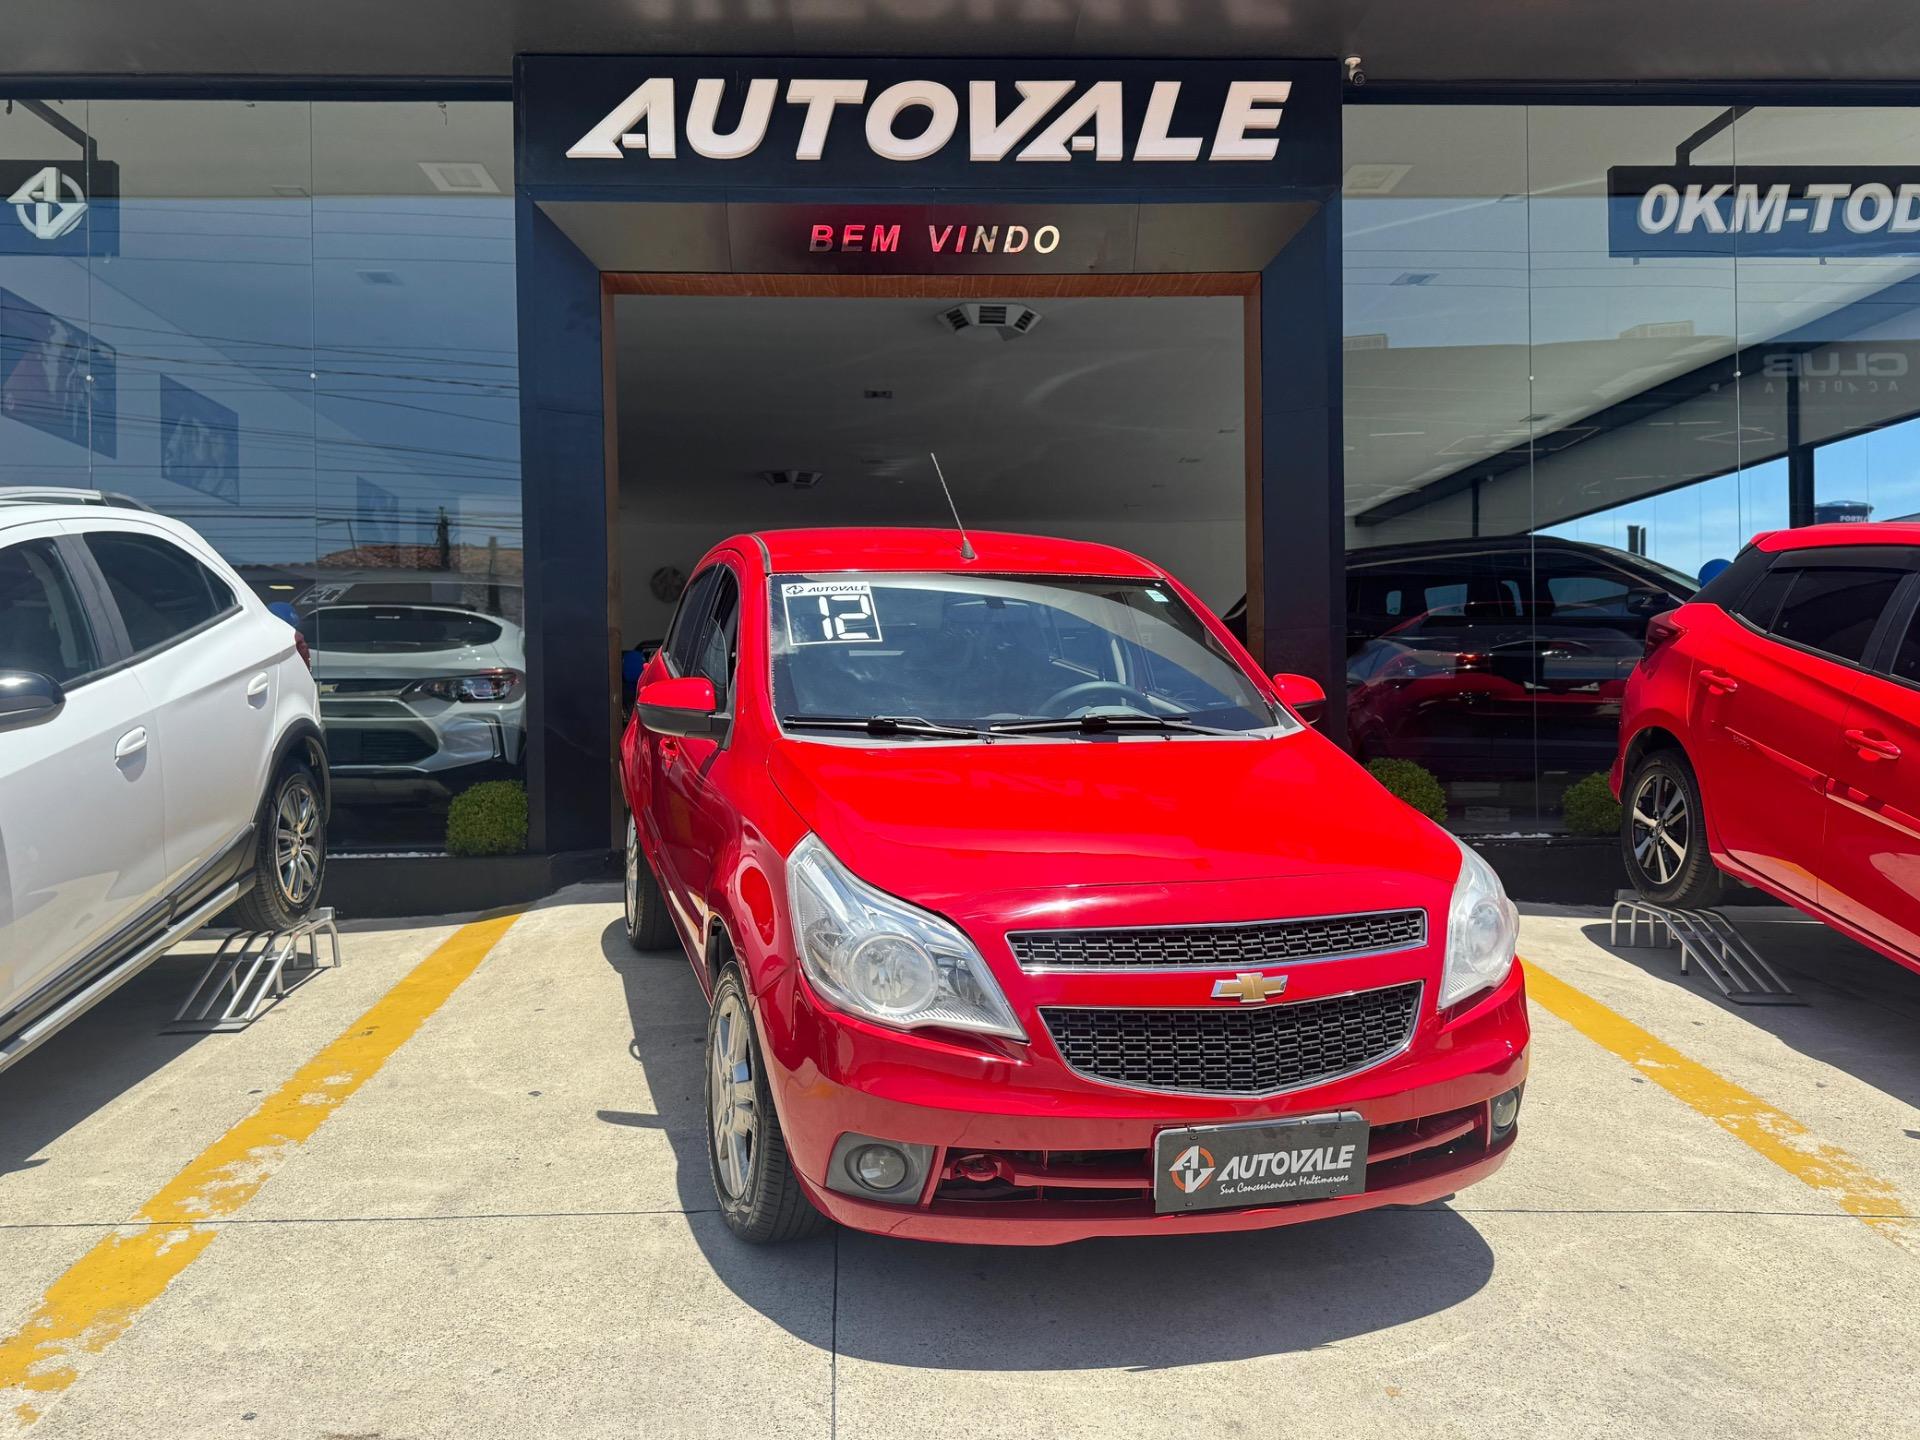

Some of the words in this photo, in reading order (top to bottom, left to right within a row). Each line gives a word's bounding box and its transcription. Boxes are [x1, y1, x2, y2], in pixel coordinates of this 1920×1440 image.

[566, 78, 1292, 161] AUTOVALE
[809, 224, 901, 253] BEM
[928, 224, 1060, 254] VINDO
[808, 585, 867, 593] AUTOVALE
[818, 594, 872, 641] 12
[1217, 1144, 1356, 1181] AUTOVALE
[1219, 1183, 1235, 1195] Sua
[1298, 1174, 1349, 1186] Multimarcas
